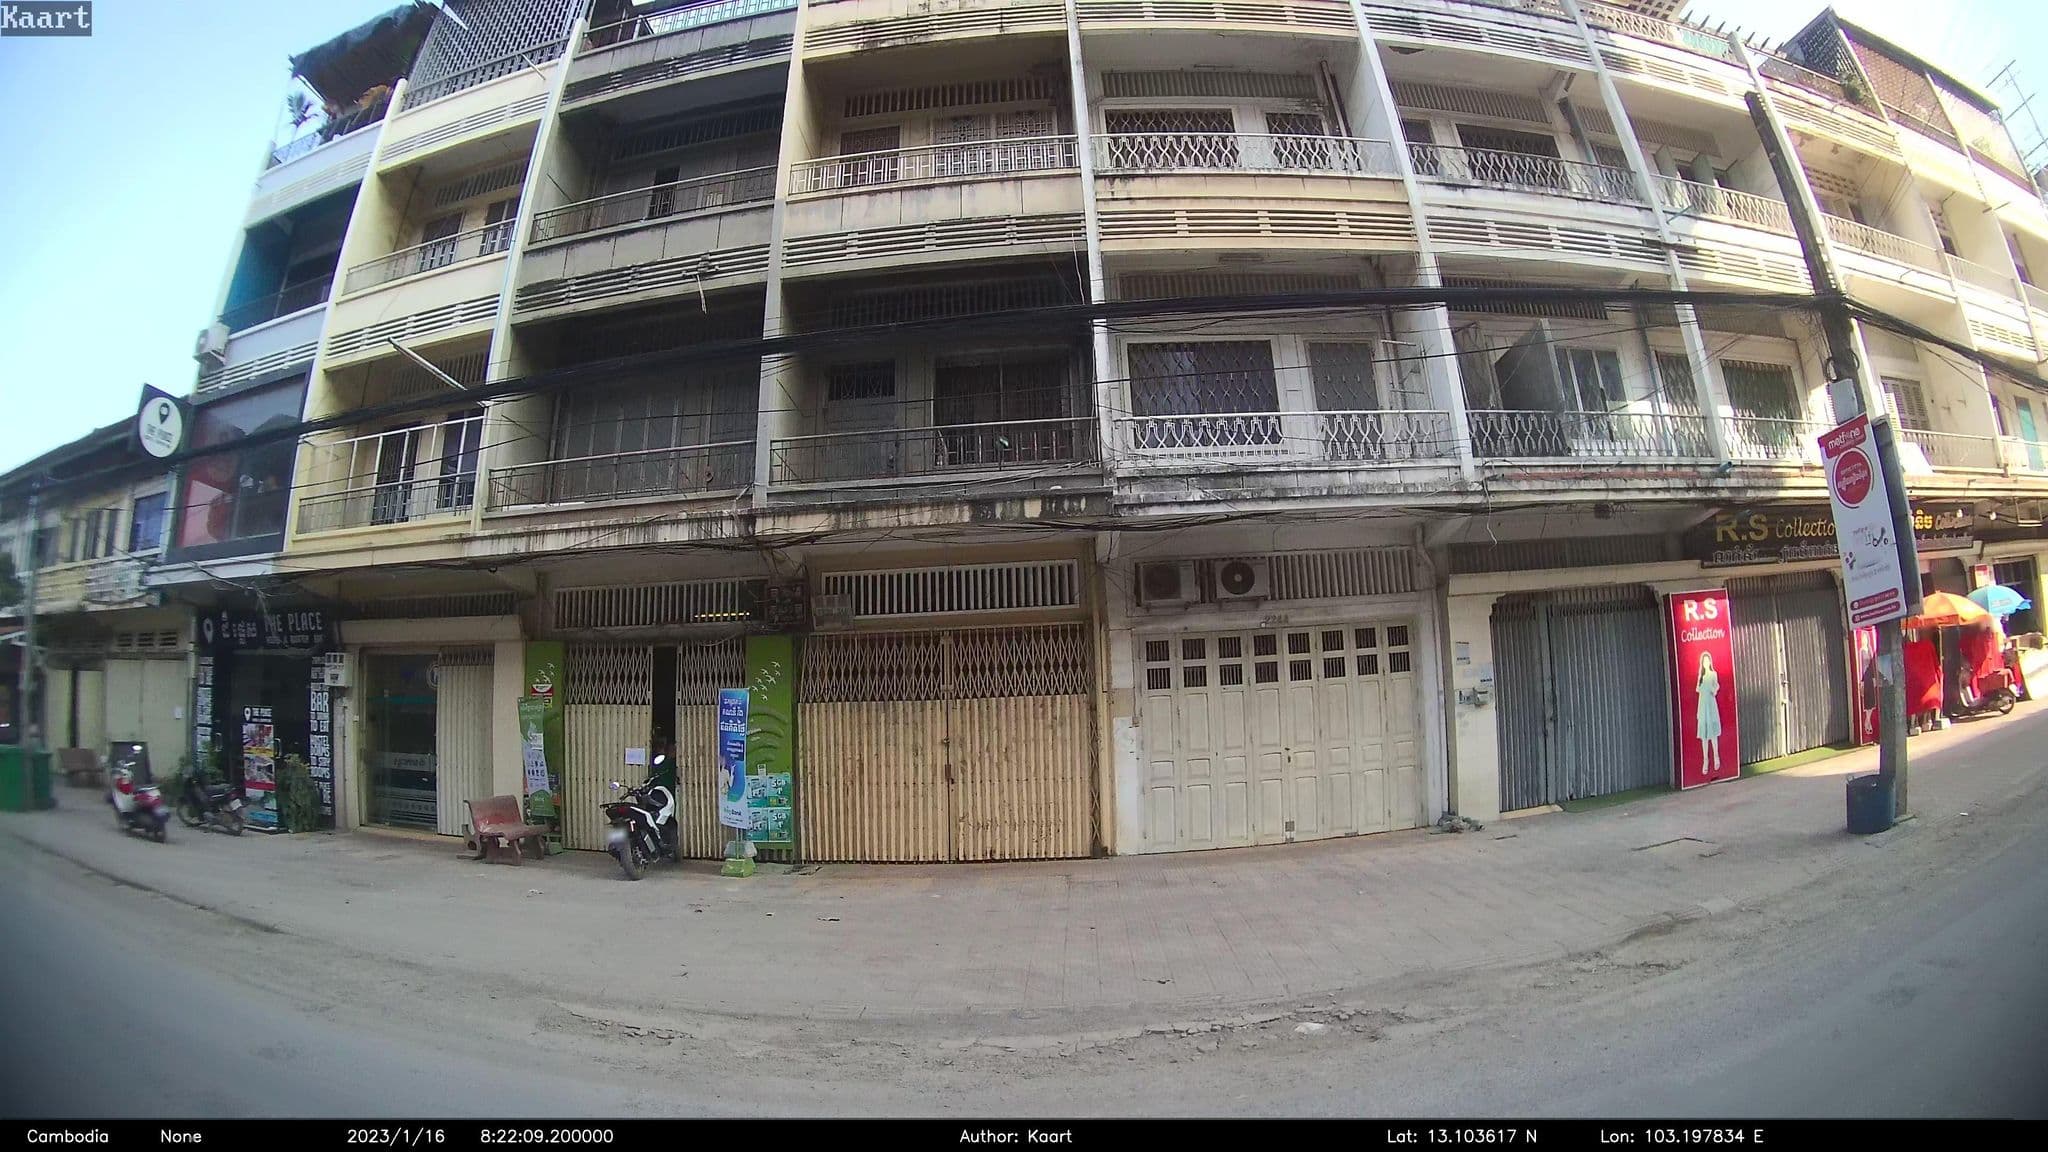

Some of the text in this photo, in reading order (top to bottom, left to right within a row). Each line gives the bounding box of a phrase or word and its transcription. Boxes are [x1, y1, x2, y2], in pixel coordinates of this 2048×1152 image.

[1716, 513, 1769, 542] R.S
[1775, 516, 1836, 539] Collectio
[1683, 598, 1718, 622] R.S
[264, 611, 322, 632] THE PLACE
[1681, 627, 1726, 642] Collection
[310, 691, 329, 712] BAR
